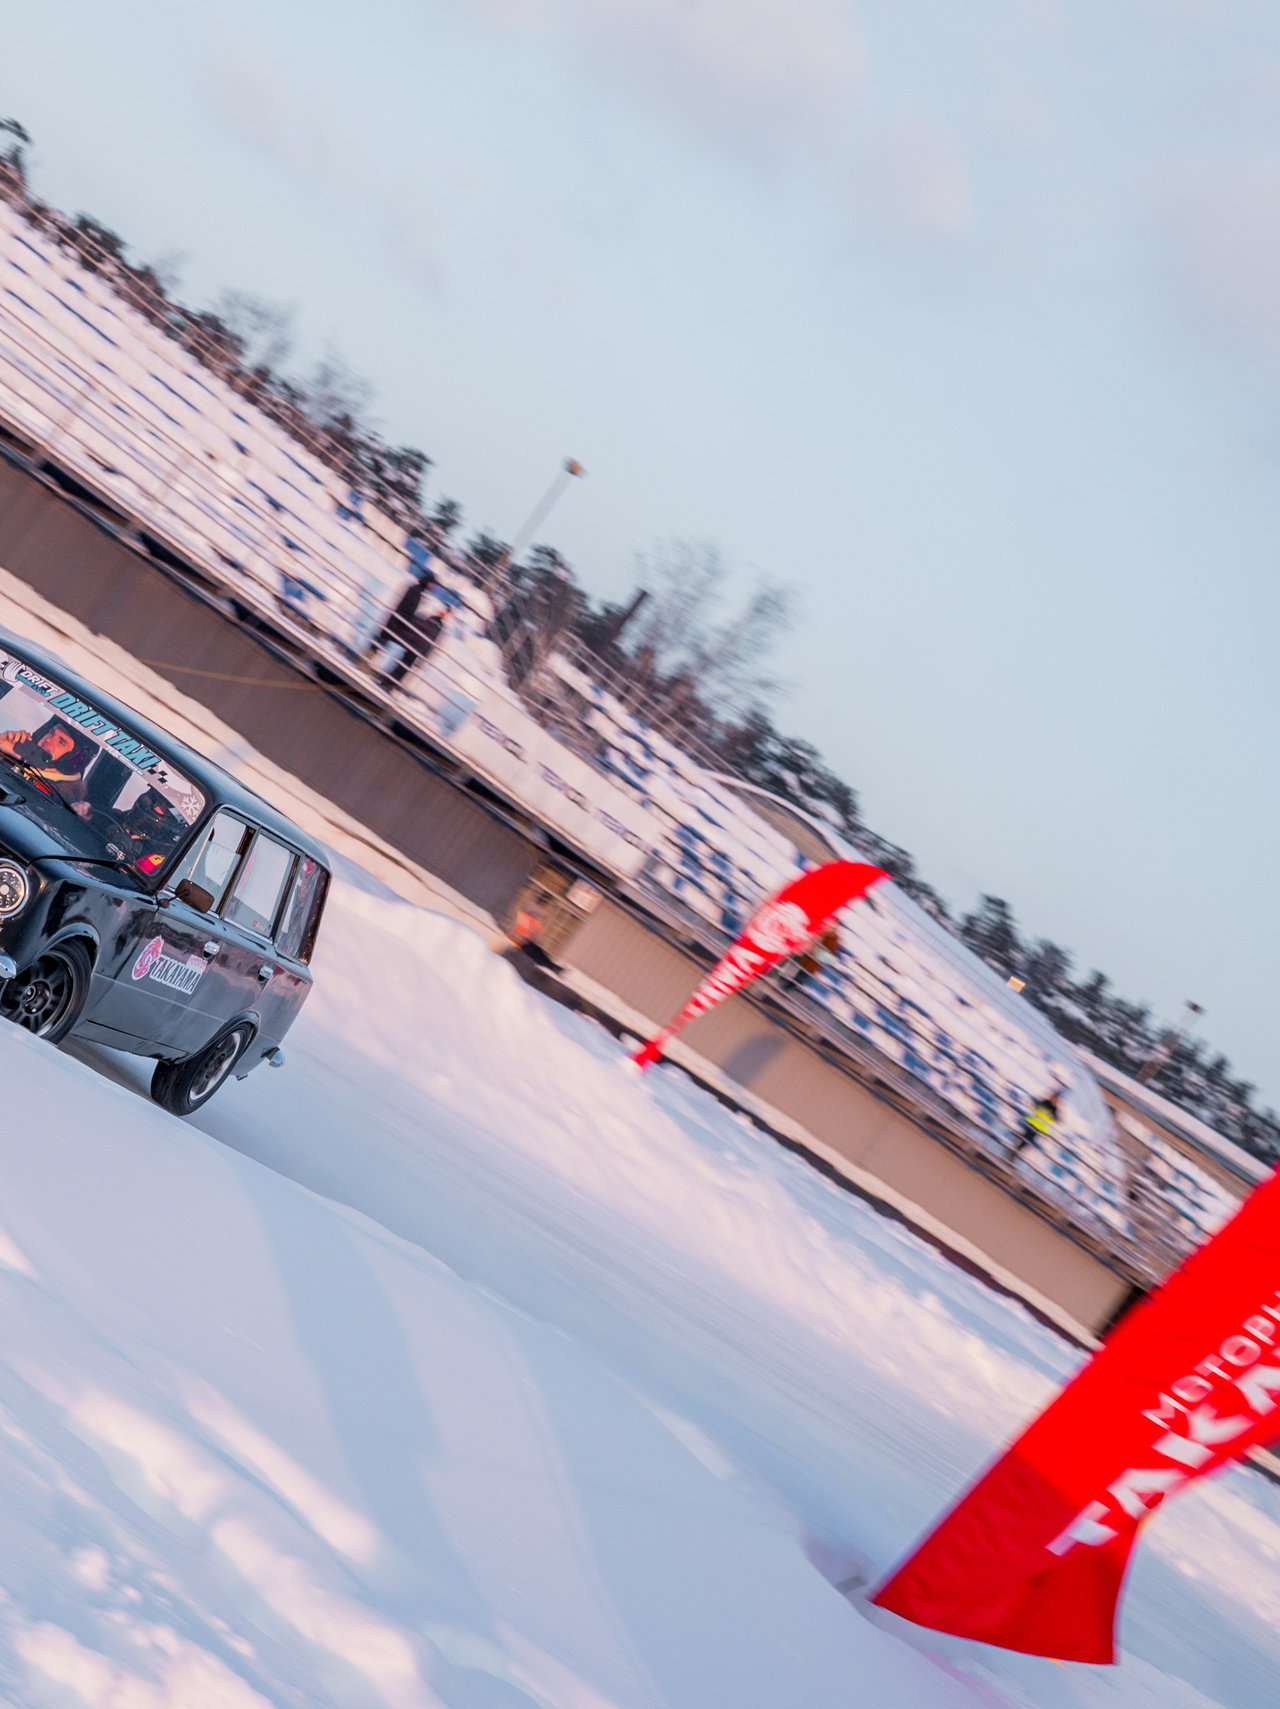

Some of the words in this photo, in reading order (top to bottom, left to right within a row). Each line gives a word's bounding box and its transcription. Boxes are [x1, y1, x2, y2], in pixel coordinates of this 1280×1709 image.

[19, 670, 60, 693] DRIFT
[47, 692, 119, 736] DRIFT
[105, 728, 161, 770] TAXI
[150, 955, 202, 994] TAKAYAMA
[1044, 1345, 1280, 1557] TAKA
